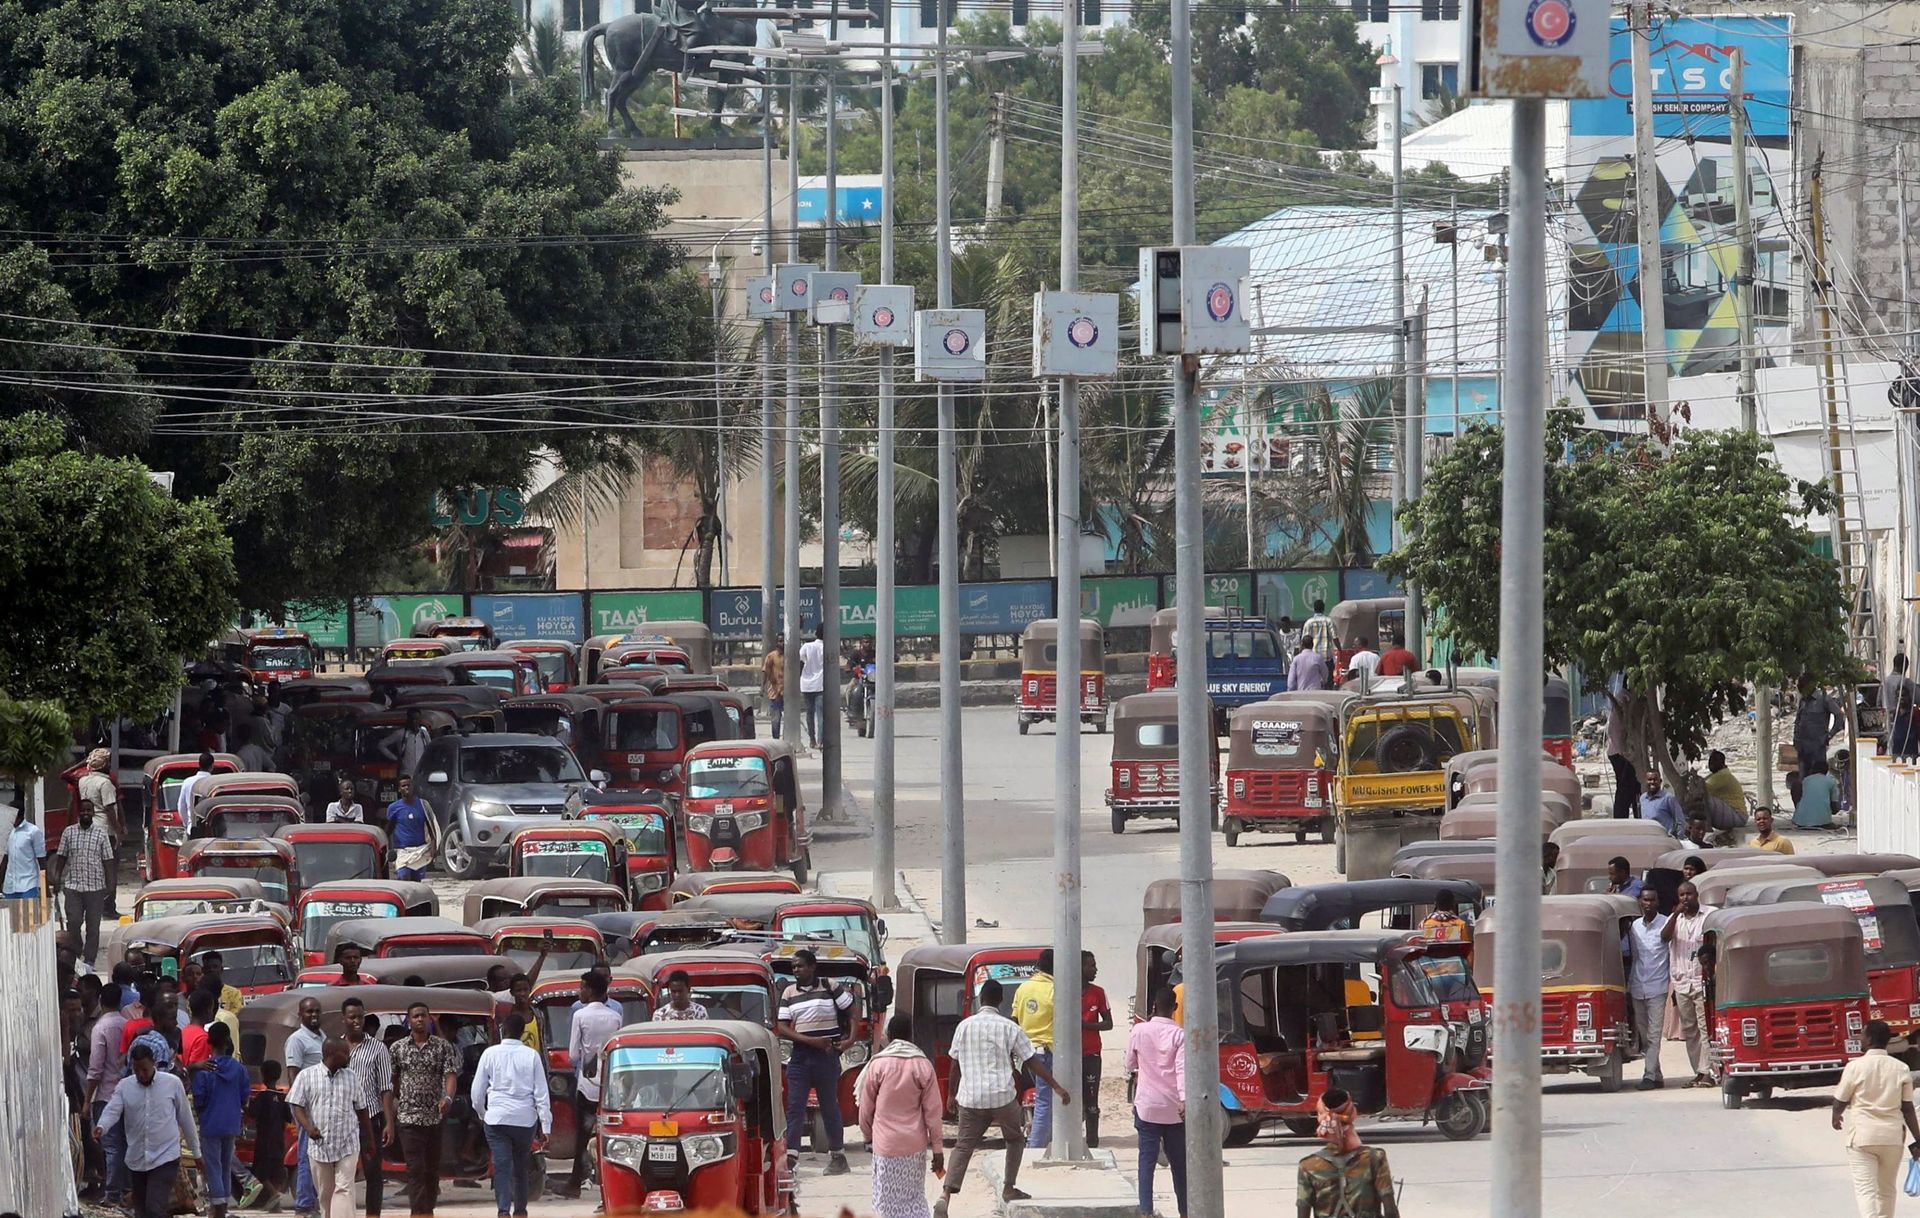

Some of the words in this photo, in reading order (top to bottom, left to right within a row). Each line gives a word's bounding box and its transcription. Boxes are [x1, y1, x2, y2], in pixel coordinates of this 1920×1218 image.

[1211, 578, 1239, 593] $20
[1010, 609, 1047, 618] HOYGA
[537, 621, 576, 630] HOYGA
[1222, 682, 1238, 693] SKY
[1240, 682, 1271, 693] ENERGY
